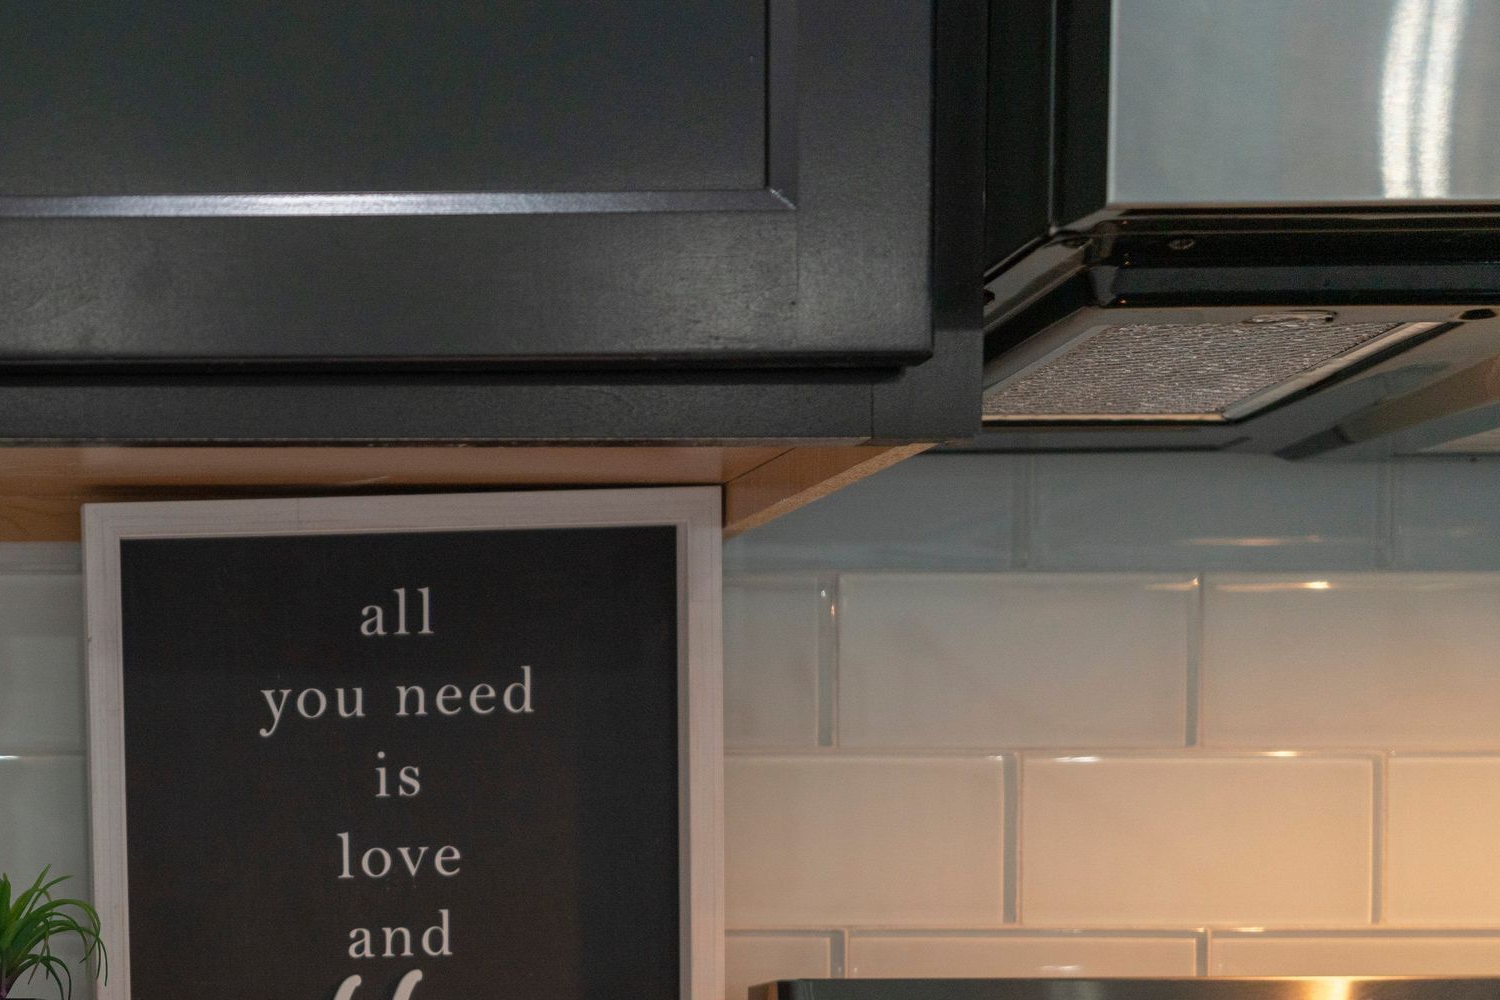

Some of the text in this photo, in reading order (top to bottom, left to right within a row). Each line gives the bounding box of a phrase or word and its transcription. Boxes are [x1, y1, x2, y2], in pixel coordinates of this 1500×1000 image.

[360, 586, 435, 636] all
[259, 665, 535, 737] you need
[375, 751, 422, 797] is
[337, 832, 462, 879] love
[348, 909, 453, 958] and
